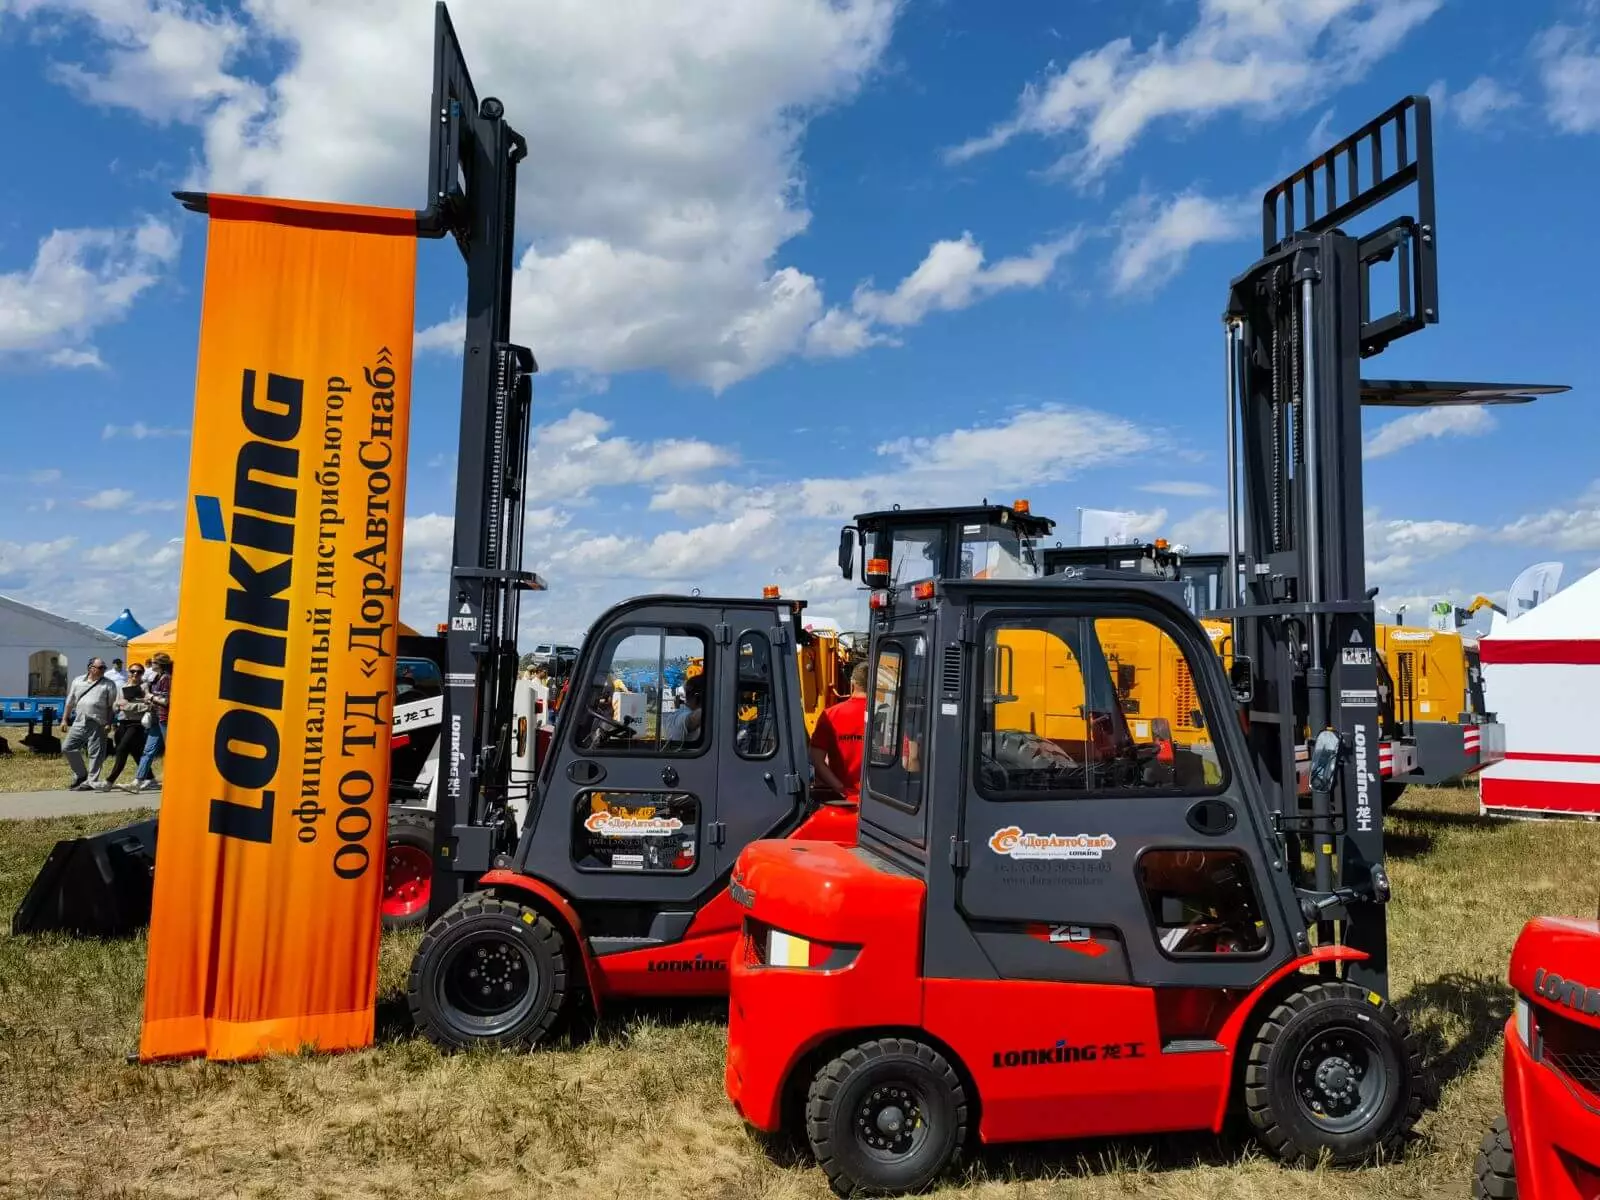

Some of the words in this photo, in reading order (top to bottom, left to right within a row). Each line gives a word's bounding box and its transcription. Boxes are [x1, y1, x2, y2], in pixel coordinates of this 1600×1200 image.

[348, 346, 396, 678] «ДорАвтоСнаб»
[194, 368, 304, 844] LONKING
[292, 608, 332, 843] официальный
[315, 376, 352, 598] дистрибьютор
[341, 690, 388, 757] ТД
[404, 707, 435, 722] 龙工
[1354, 724, 1375, 805] LONKING
[333, 770, 375, 880] ООО
[647, 953, 727, 972] LONKING
[993, 1040, 1097, 1068] LONKING
[1101, 1042, 1145, 1059] 龙工
